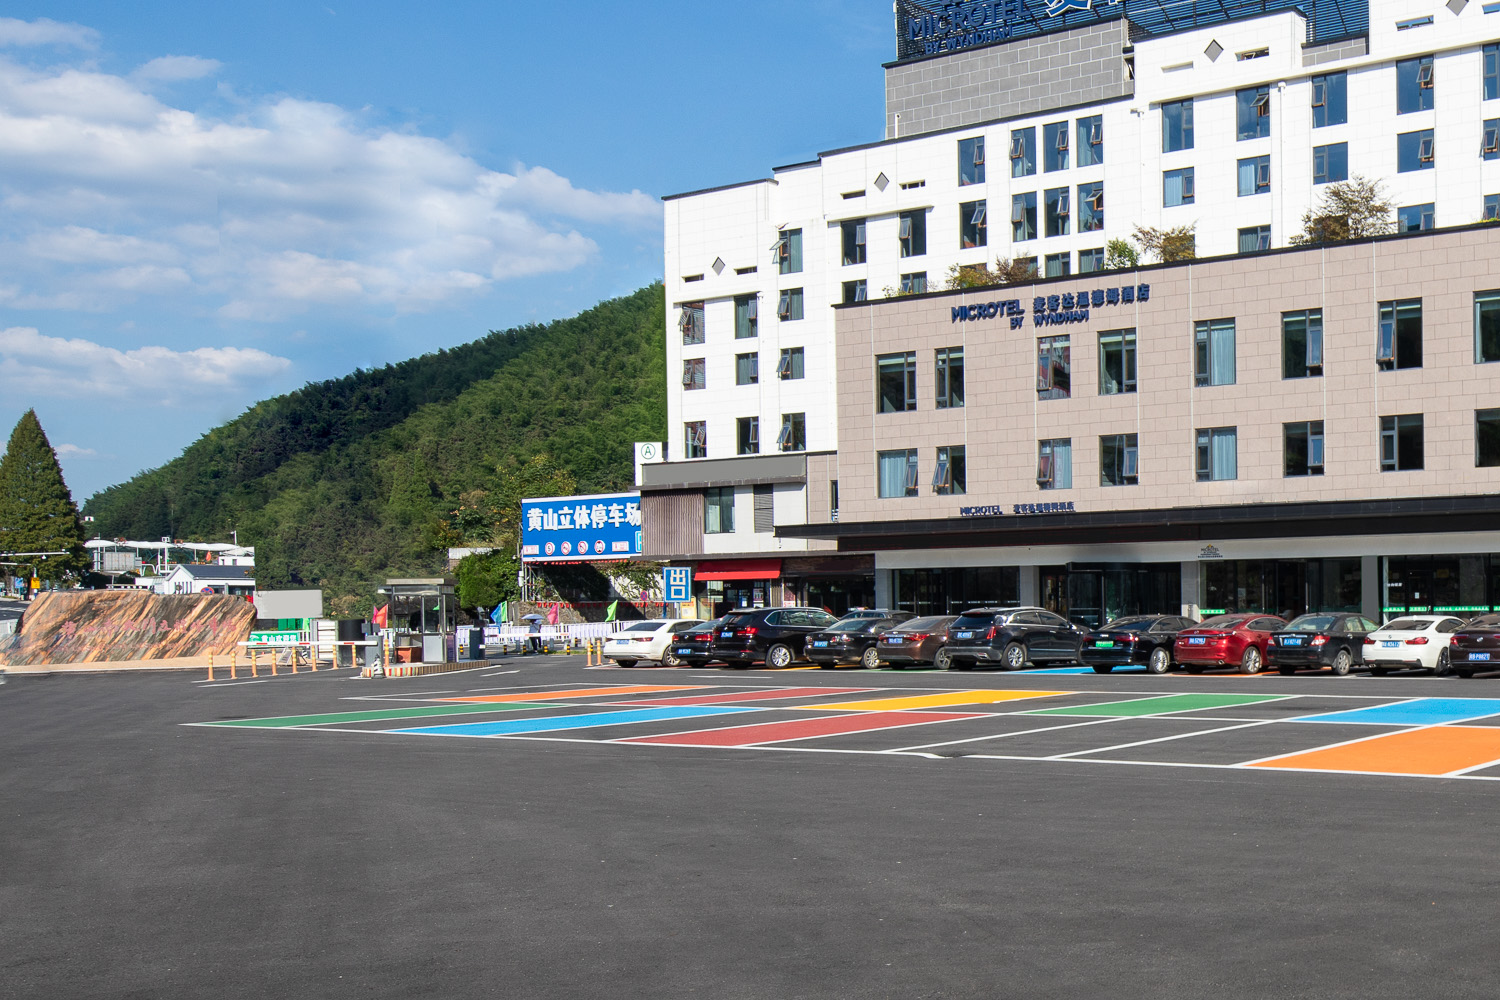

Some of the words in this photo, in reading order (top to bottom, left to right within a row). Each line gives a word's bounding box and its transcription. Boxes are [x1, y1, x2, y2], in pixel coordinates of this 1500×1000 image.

[925, 41, 941, 55] BY
[945, 25, 1014, 51] WYNDHAM
[951, 299, 1026, 323] MICROTEL
[1033, 283, 1151, 314] 麦客达温德姆酒店
[1010, 316, 1026, 331] BY
[1033, 309, 1090, 328] WYNDHAM
[527, 501, 641, 532] 黄山立体停车场
[959, 505, 1003, 517] MICROTEL
[669, 569, 686, 599] 出口
